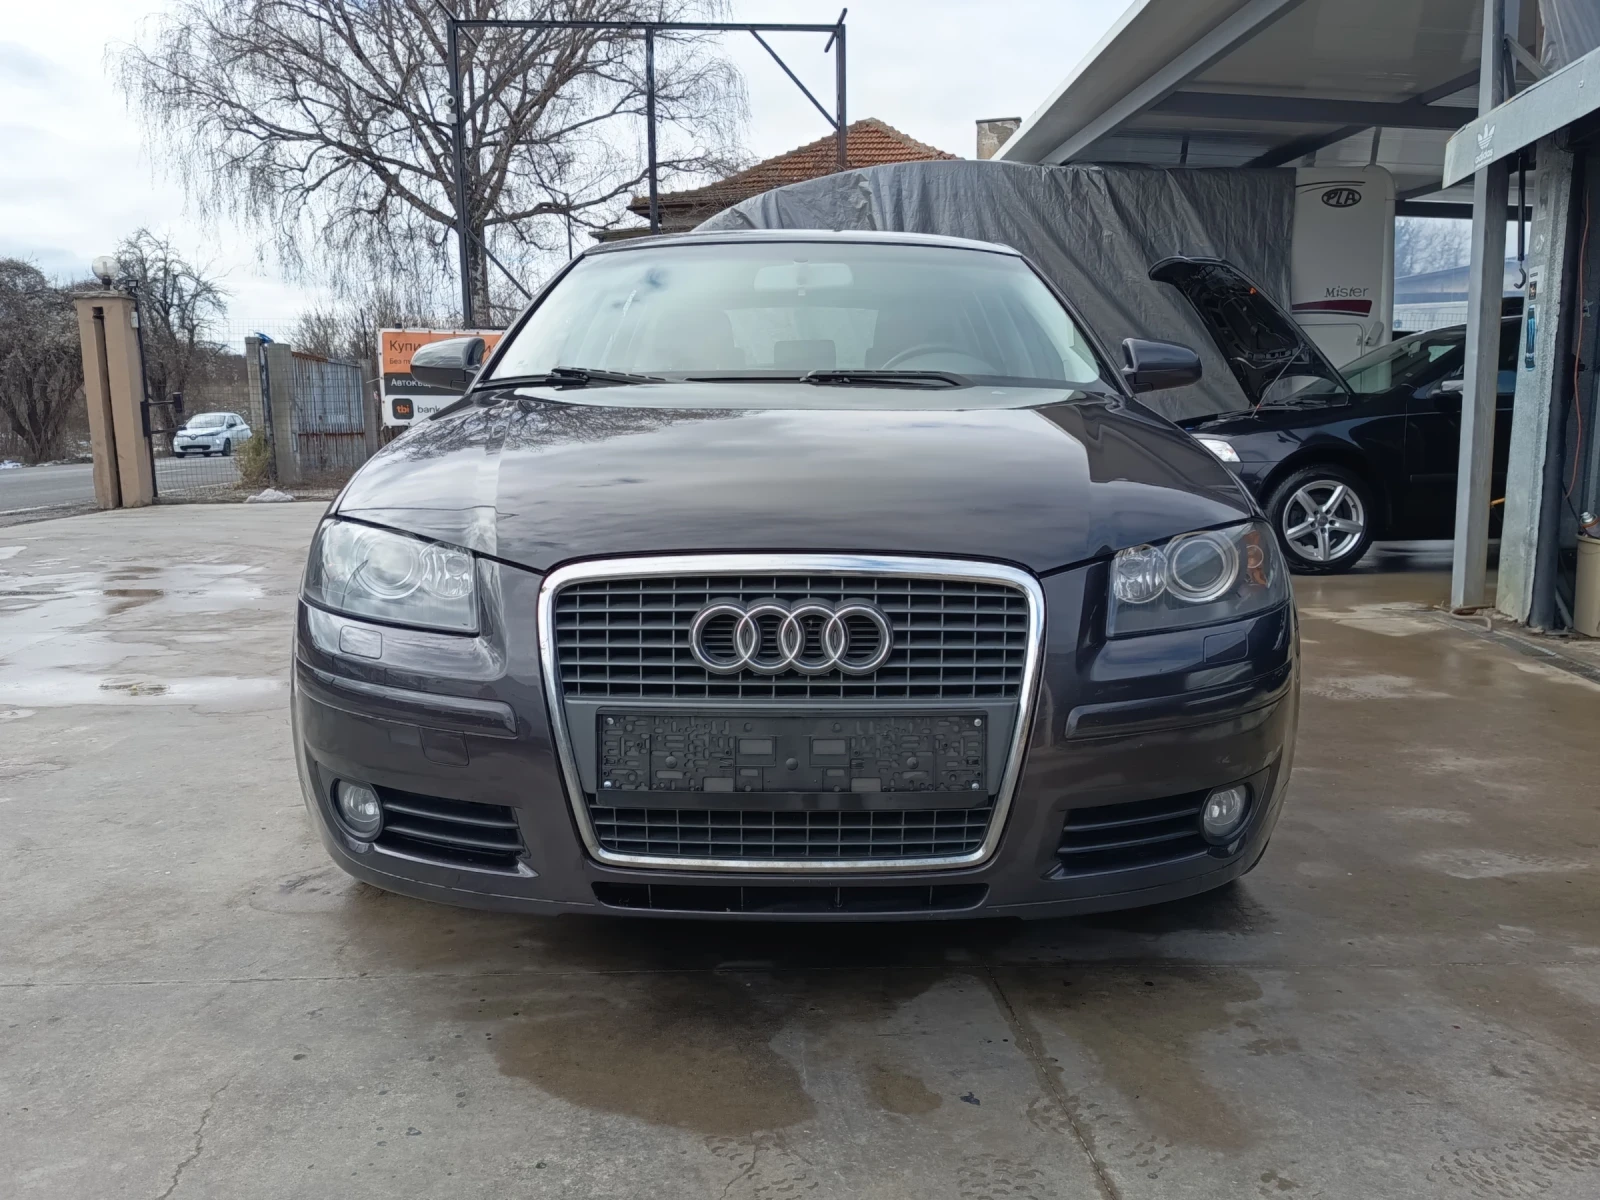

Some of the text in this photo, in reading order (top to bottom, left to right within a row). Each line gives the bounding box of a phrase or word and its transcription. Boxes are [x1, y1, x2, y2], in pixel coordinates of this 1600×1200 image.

[1475, 148, 1493, 164] adidas
[1325, 285, 1369, 298] Mister
[396, 404, 440, 414] tbi bank
